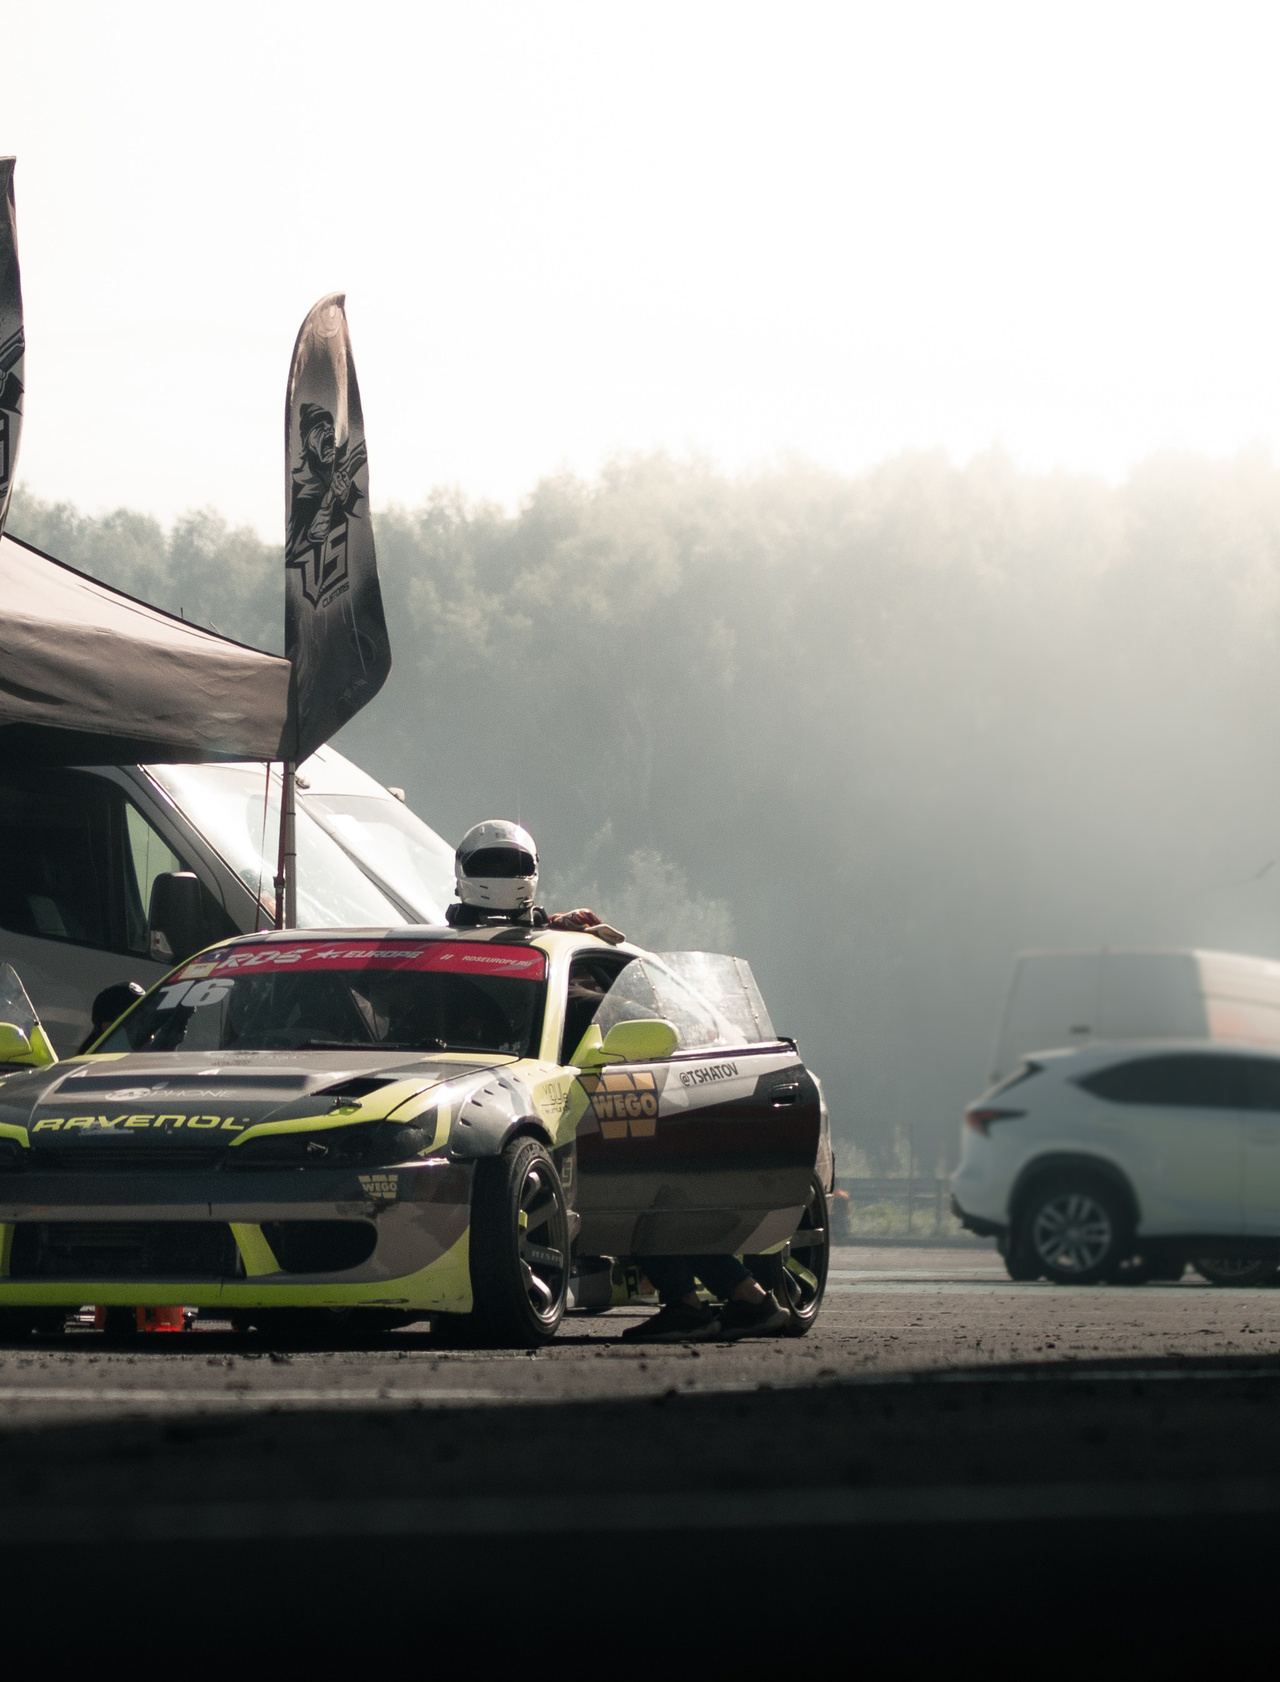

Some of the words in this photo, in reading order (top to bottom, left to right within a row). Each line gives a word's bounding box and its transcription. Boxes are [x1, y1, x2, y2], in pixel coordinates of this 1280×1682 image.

[217, 949, 314, 969] RDS
[342, 950, 424, 960] EUROPE
[156, 978, 235, 1011] 16
[679, 1062, 739, 1087] @TSHATOV
[591, 1091, 658, 1119] WEGO
[32, 1115, 245, 1132] RAVENOL
[361, 1182, 398, 1193] WEGO
